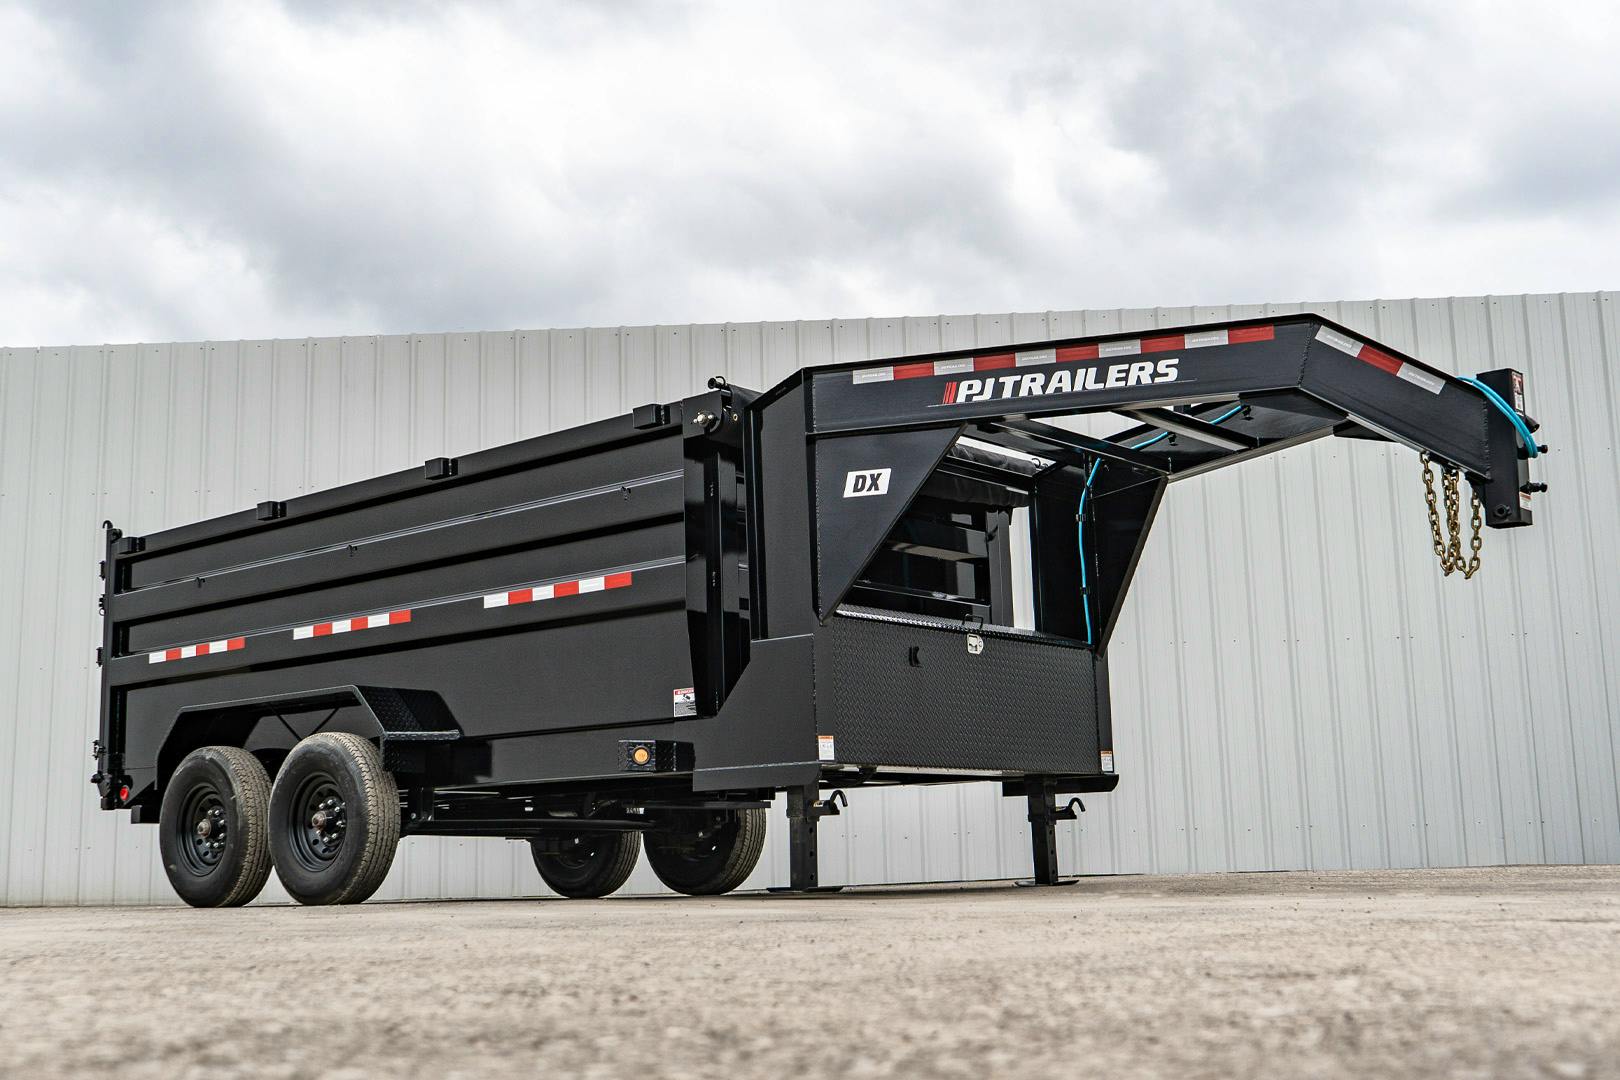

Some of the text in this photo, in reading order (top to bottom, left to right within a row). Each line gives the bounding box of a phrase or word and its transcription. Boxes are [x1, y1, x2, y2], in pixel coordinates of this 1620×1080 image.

[956, 358, 1180, 403] PJ TRAILERS
[852, 472, 882, 493] DX
